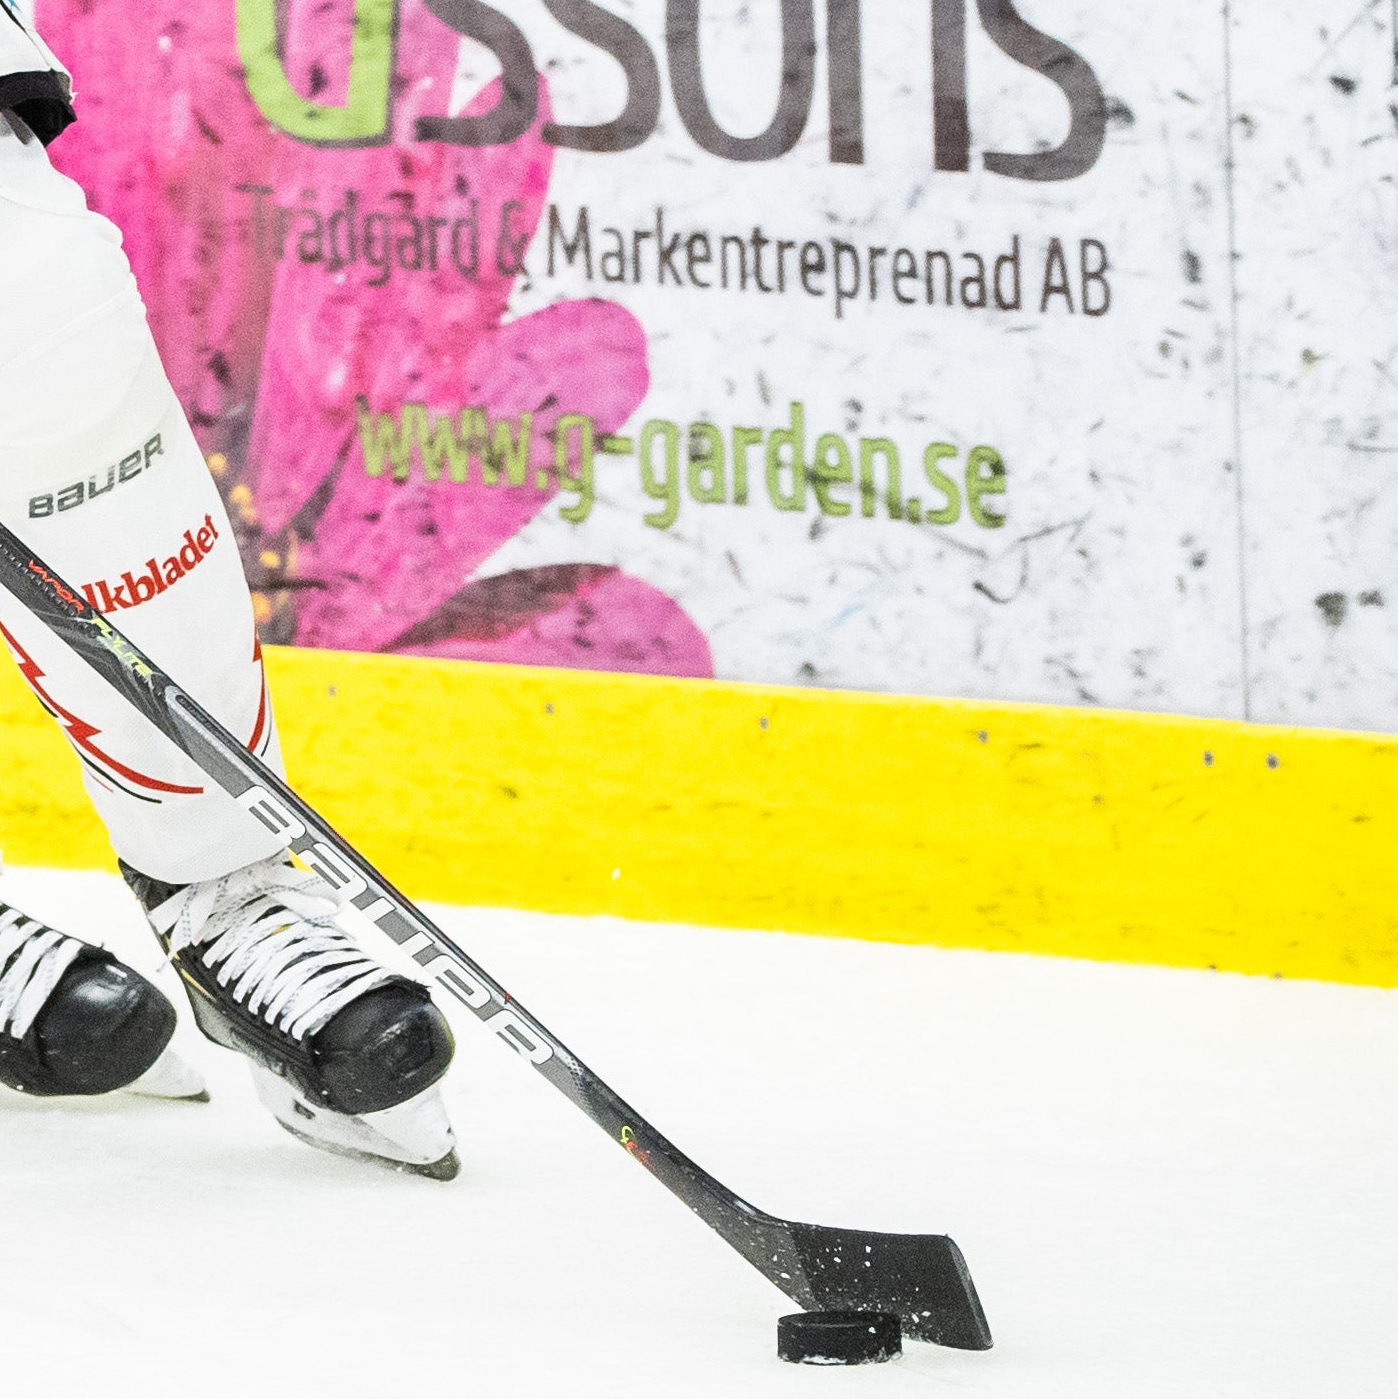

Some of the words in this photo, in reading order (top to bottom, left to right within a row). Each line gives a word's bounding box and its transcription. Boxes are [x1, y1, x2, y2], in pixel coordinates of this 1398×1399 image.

[545, 204, 1023, 317] Markentreprenad
[1037, 235, 1114, 316] AB
[355, 395, 1007, 530] www.g-garden.se
[77, 513, 221, 616] lkbladet
